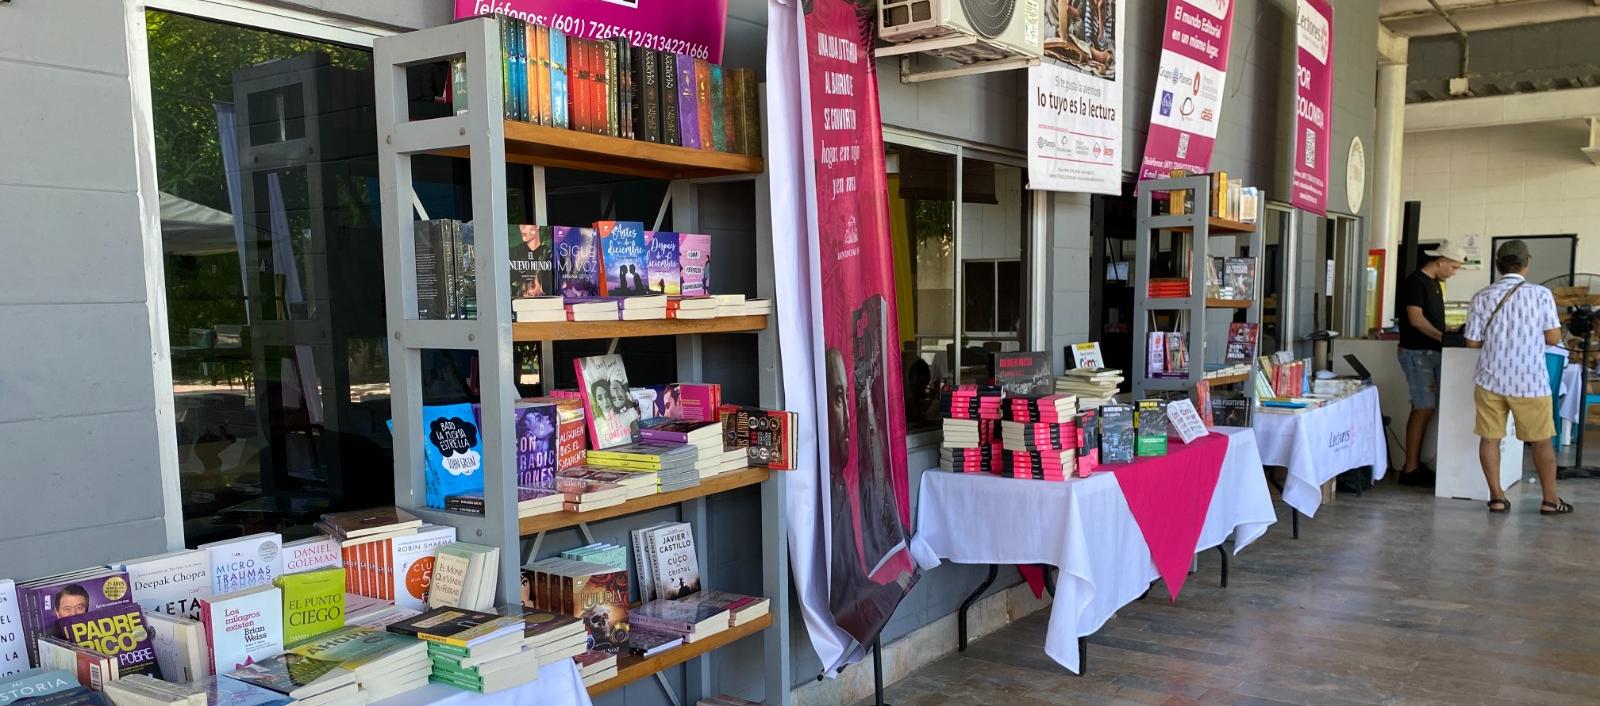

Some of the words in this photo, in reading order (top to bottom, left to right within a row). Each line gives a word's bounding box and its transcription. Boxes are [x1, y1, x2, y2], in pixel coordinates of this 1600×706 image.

[474, 0, 548, 27] Teléfonos:
[551, 13, 585, 37] (601)
[1174, 5, 1183, 20] El
[1181, 11, 1202, 29] mundo
[1201, 17, 1222, 38] Editorial
[1171, 29, 1181, 41] en
[1181, 32, 1190, 45] un
[1189, 34, 1207, 52] mismo
[1297, 64, 1311, 90] POR
[1037, 86, 1047, 107] lo
[1048, 92, 1068, 116] tuyo
[1069, 99, 1078, 114] es
[1079, 96, 1087, 116] la
[1088, 98, 1116, 121] lectura
[1297, 95, 1325, 129] COLOMBIA
[560, 242, 596, 258] SIGUE
[607, 240, 643, 256] diciembre
[509, 260, 530, 271] NUEVO
[530, 260, 552, 271] MUNDO
[436, 431, 444, 440] LA
[445, 428, 467, 440] MISMA
[560, 424, 585, 442] ALGUIEN
[440, 438, 470, 451] ESTRELLA
[520, 435, 537, 453] ON
[520, 449, 555, 471] RADIC
[520, 466, 554, 486] IONES
[660, 540, 691, 553] CASTILLO
[662, 532, 686, 544] JAVIER
[294, 544, 330, 559] DANIEL
[398, 544, 420, 552] ROBIN
[216, 559, 255, 574] MICRO
[288, 553, 337, 570] GOLEMAN
[414, 562, 432, 572] CLU
[667, 554, 688, 566] CUCO
[134, 577, 170, 590] Deepak
[172, 569, 206, 583] Chopra
[216, 565, 271, 581] TRAUMAS
[421, 571, 431, 588] 5
[668, 566, 690, 577] CRISTAL
[155, 597, 202, 615] ETA
[289, 600, 301, 610] EL
[305, 593, 342, 607] PUNTO
[225, 611, 261, 625] milagros
[289, 606, 341, 627] CIEGO
[72, 611, 142, 643] PADRE
[225, 620, 255, 632] existen
[244, 625, 265, 635] Brian
[244, 633, 268, 643] Weiss
[120, 648, 154, 665] POBRE
[0, 678, 68, 702] STORIA
